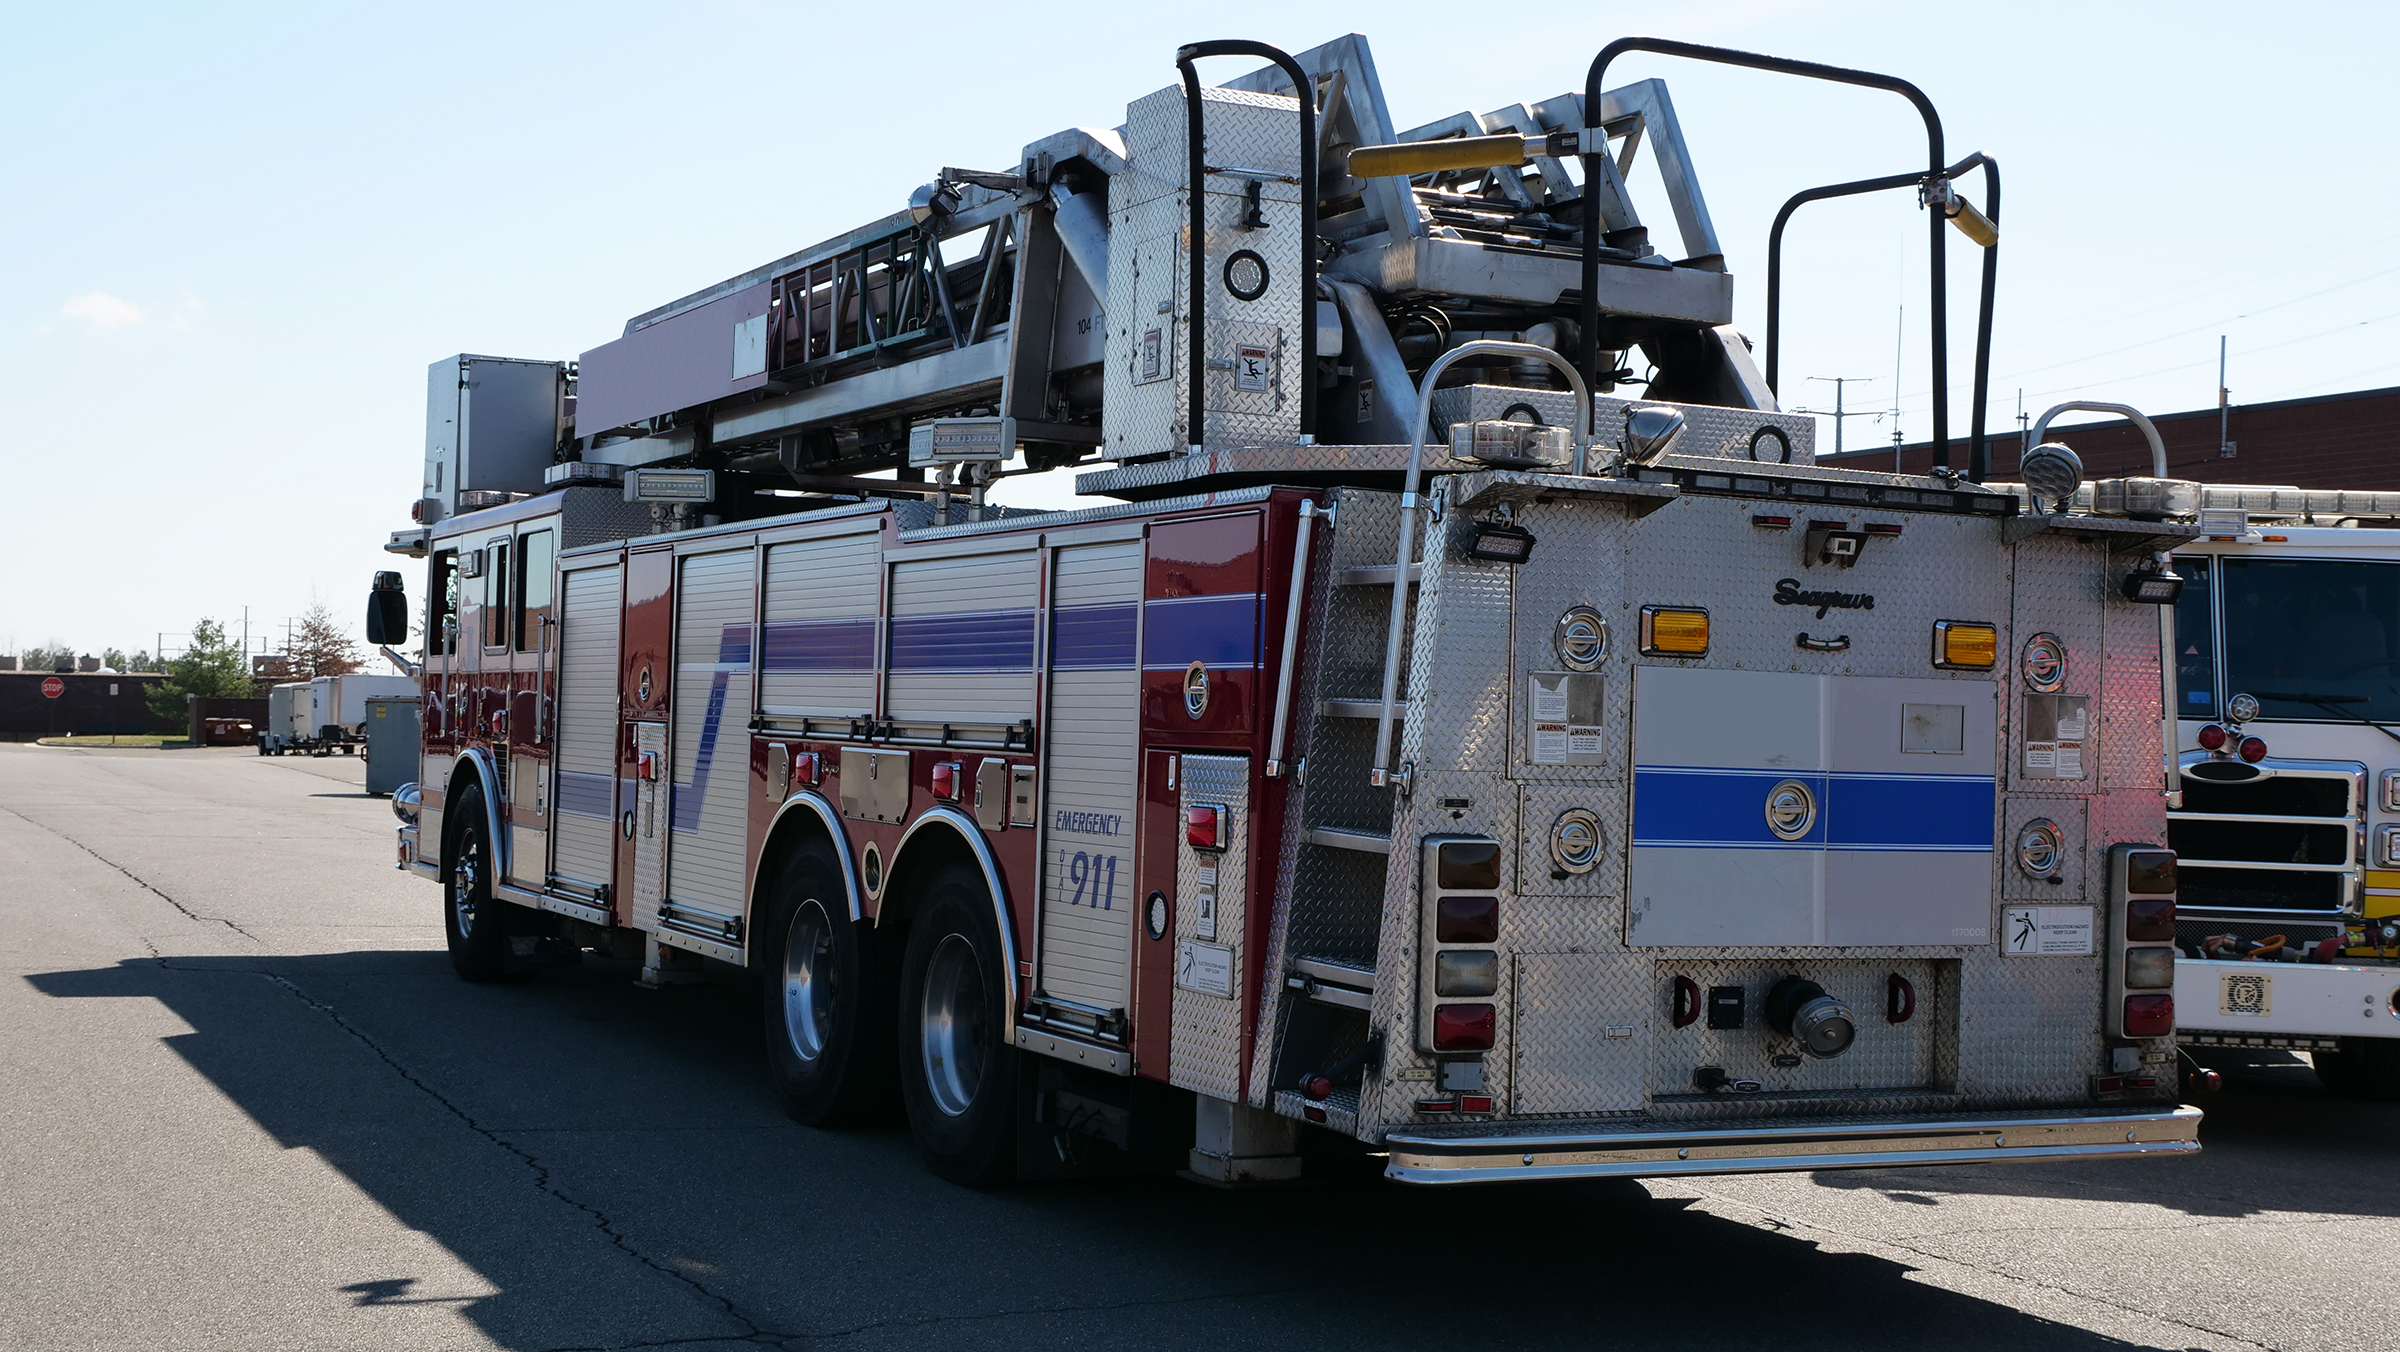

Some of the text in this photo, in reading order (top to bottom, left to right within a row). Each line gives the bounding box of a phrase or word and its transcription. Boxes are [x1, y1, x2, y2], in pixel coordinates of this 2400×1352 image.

[1077, 314, 1106, 335] 104 FT
[1773, 578, 1875, 619] Seagrave
[43, 683, 63, 692] STOP
[1541, 723, 1566, 732] WARNING
[1574, 728, 1601, 736] WARNING
[2032, 744, 2054, 752] WARNING
[1055, 810, 1121, 837] EMERGENCY
[1070, 850, 1117, 911] 911
